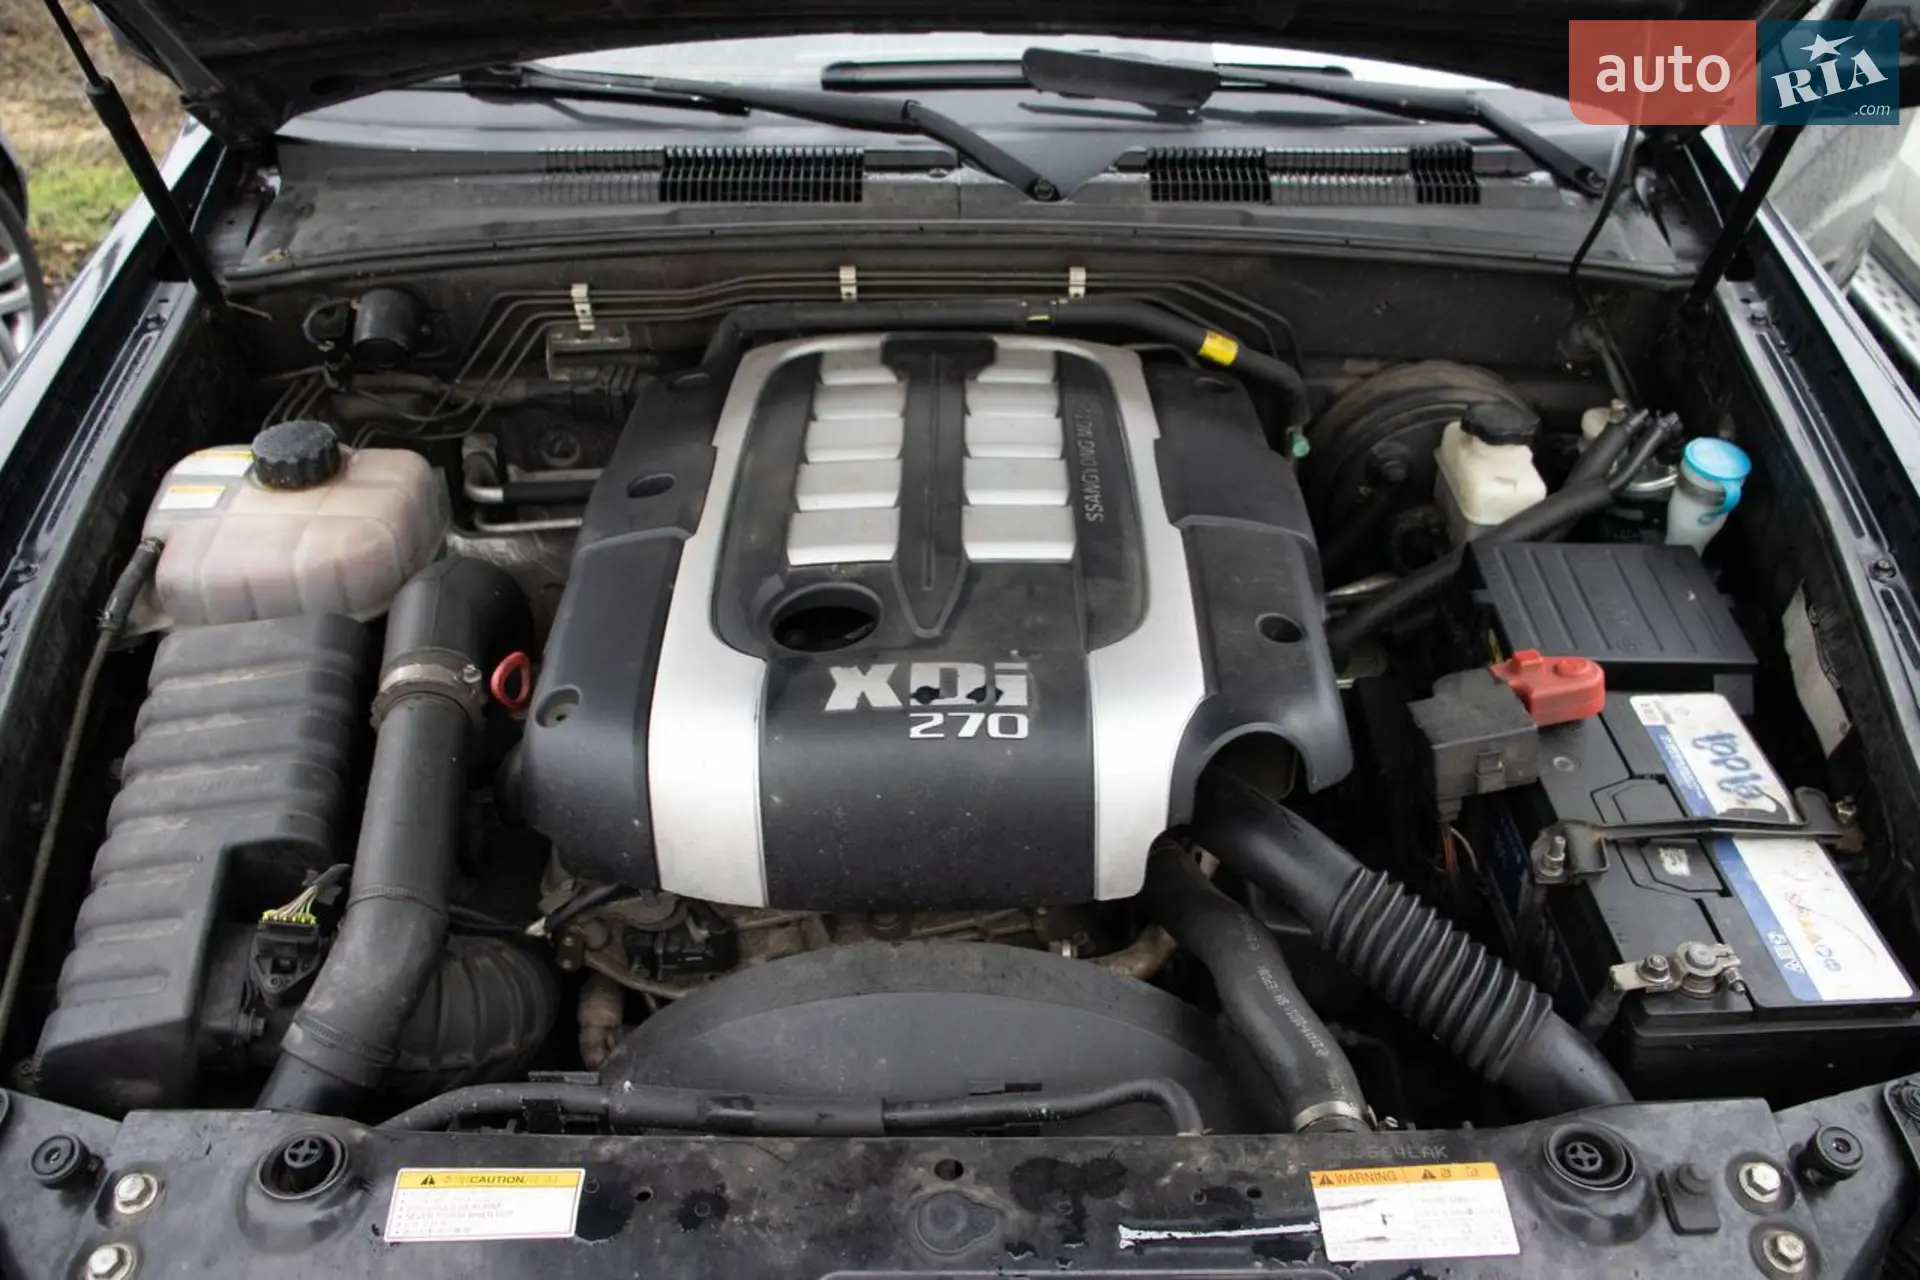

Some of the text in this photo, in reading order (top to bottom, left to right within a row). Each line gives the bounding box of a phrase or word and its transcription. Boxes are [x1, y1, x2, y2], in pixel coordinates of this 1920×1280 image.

[824, 661, 1029, 711] XDi
[909, 712, 1029, 739] 270
[469, 1175, 525, 1184] CAUTION
[1335, 1171, 1397, 1184] WARNING
